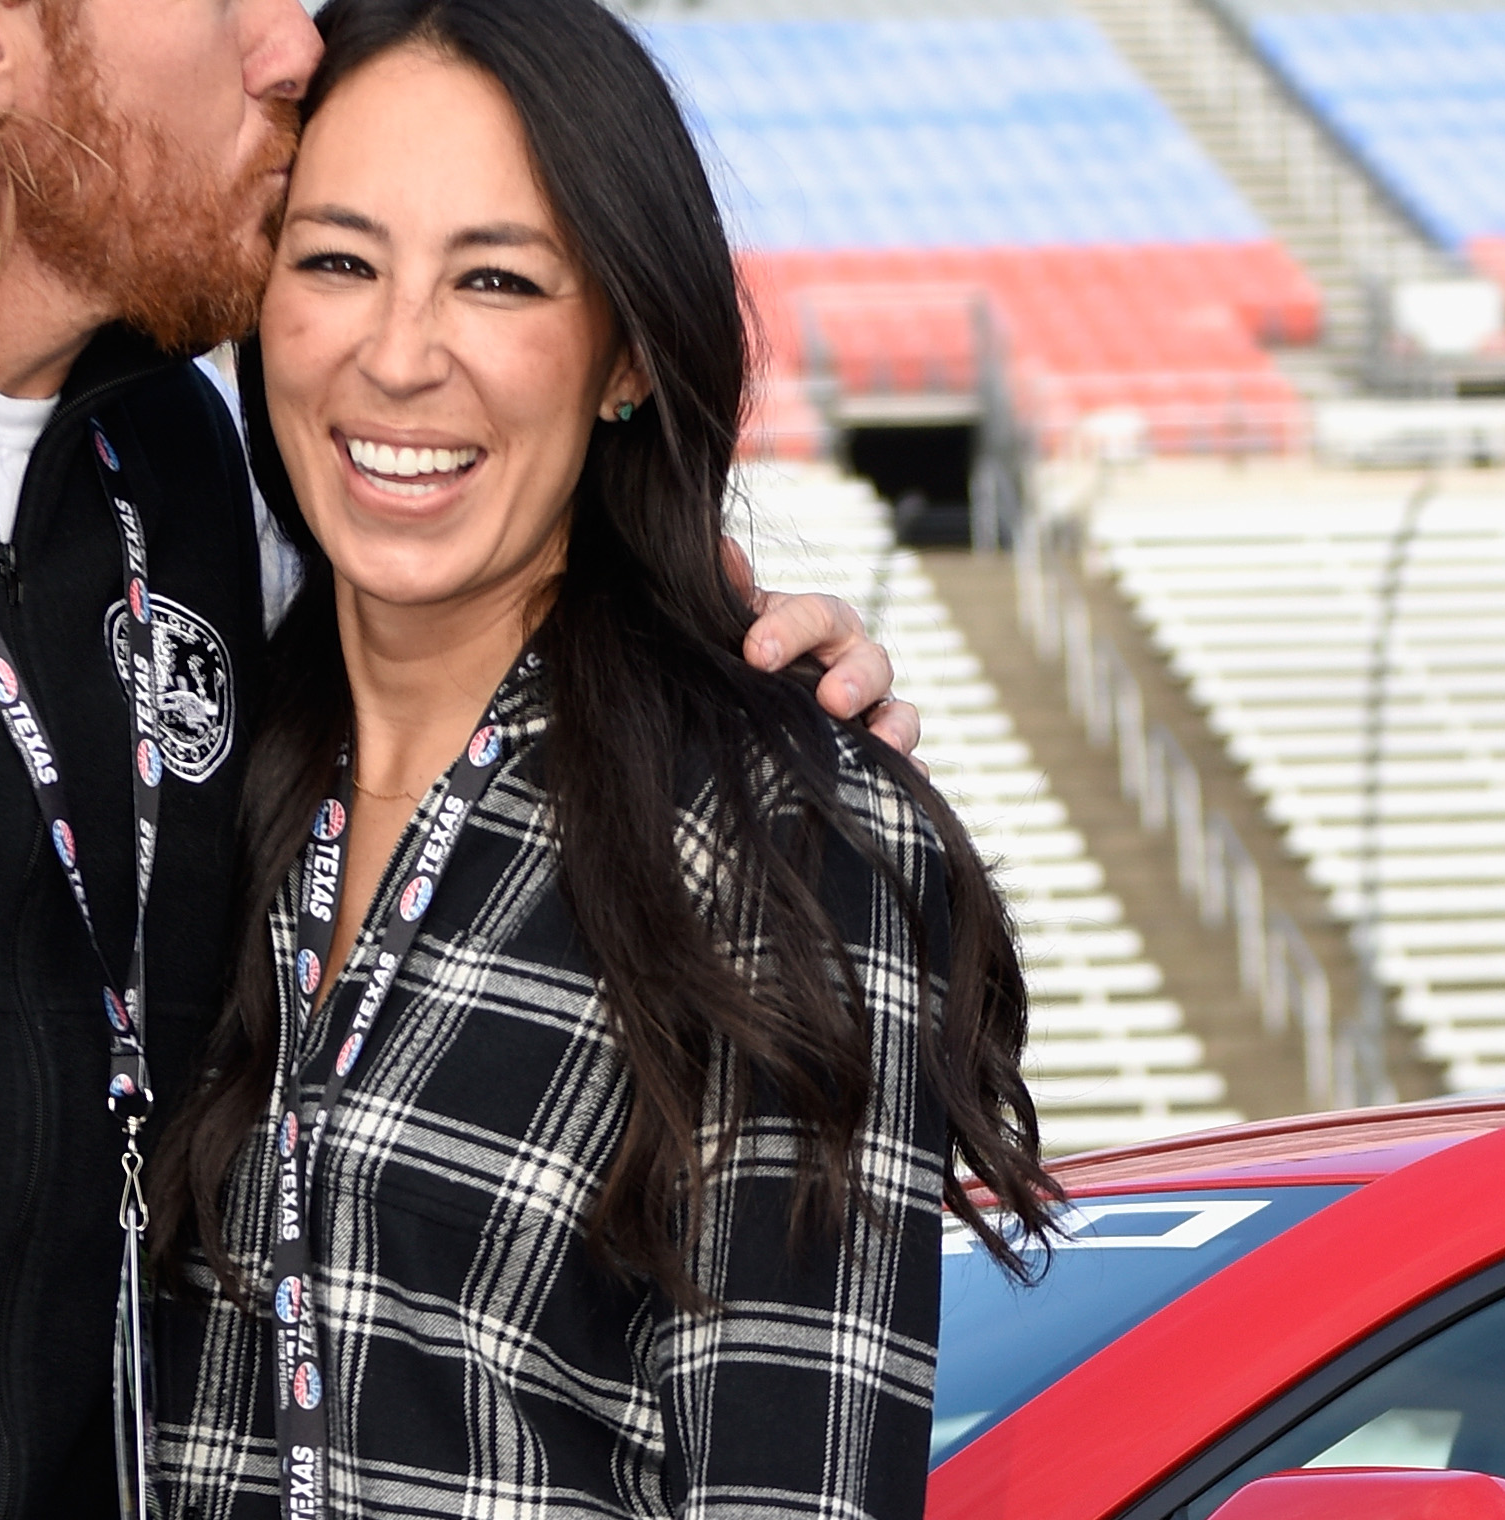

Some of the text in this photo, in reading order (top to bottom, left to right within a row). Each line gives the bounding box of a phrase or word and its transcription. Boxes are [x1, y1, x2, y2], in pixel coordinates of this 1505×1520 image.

[114, 497, 142, 572] TEXAS
[132, 653, 158, 736] TEXAS
[9, 700, 58, 784] TEXAS
[416, 794, 464, 872] TEXAS
[309, 843, 341, 923] TEXAS
[352, 951, 396, 1029] TEXAS
[282, 1157, 301, 1241] TEXAS
